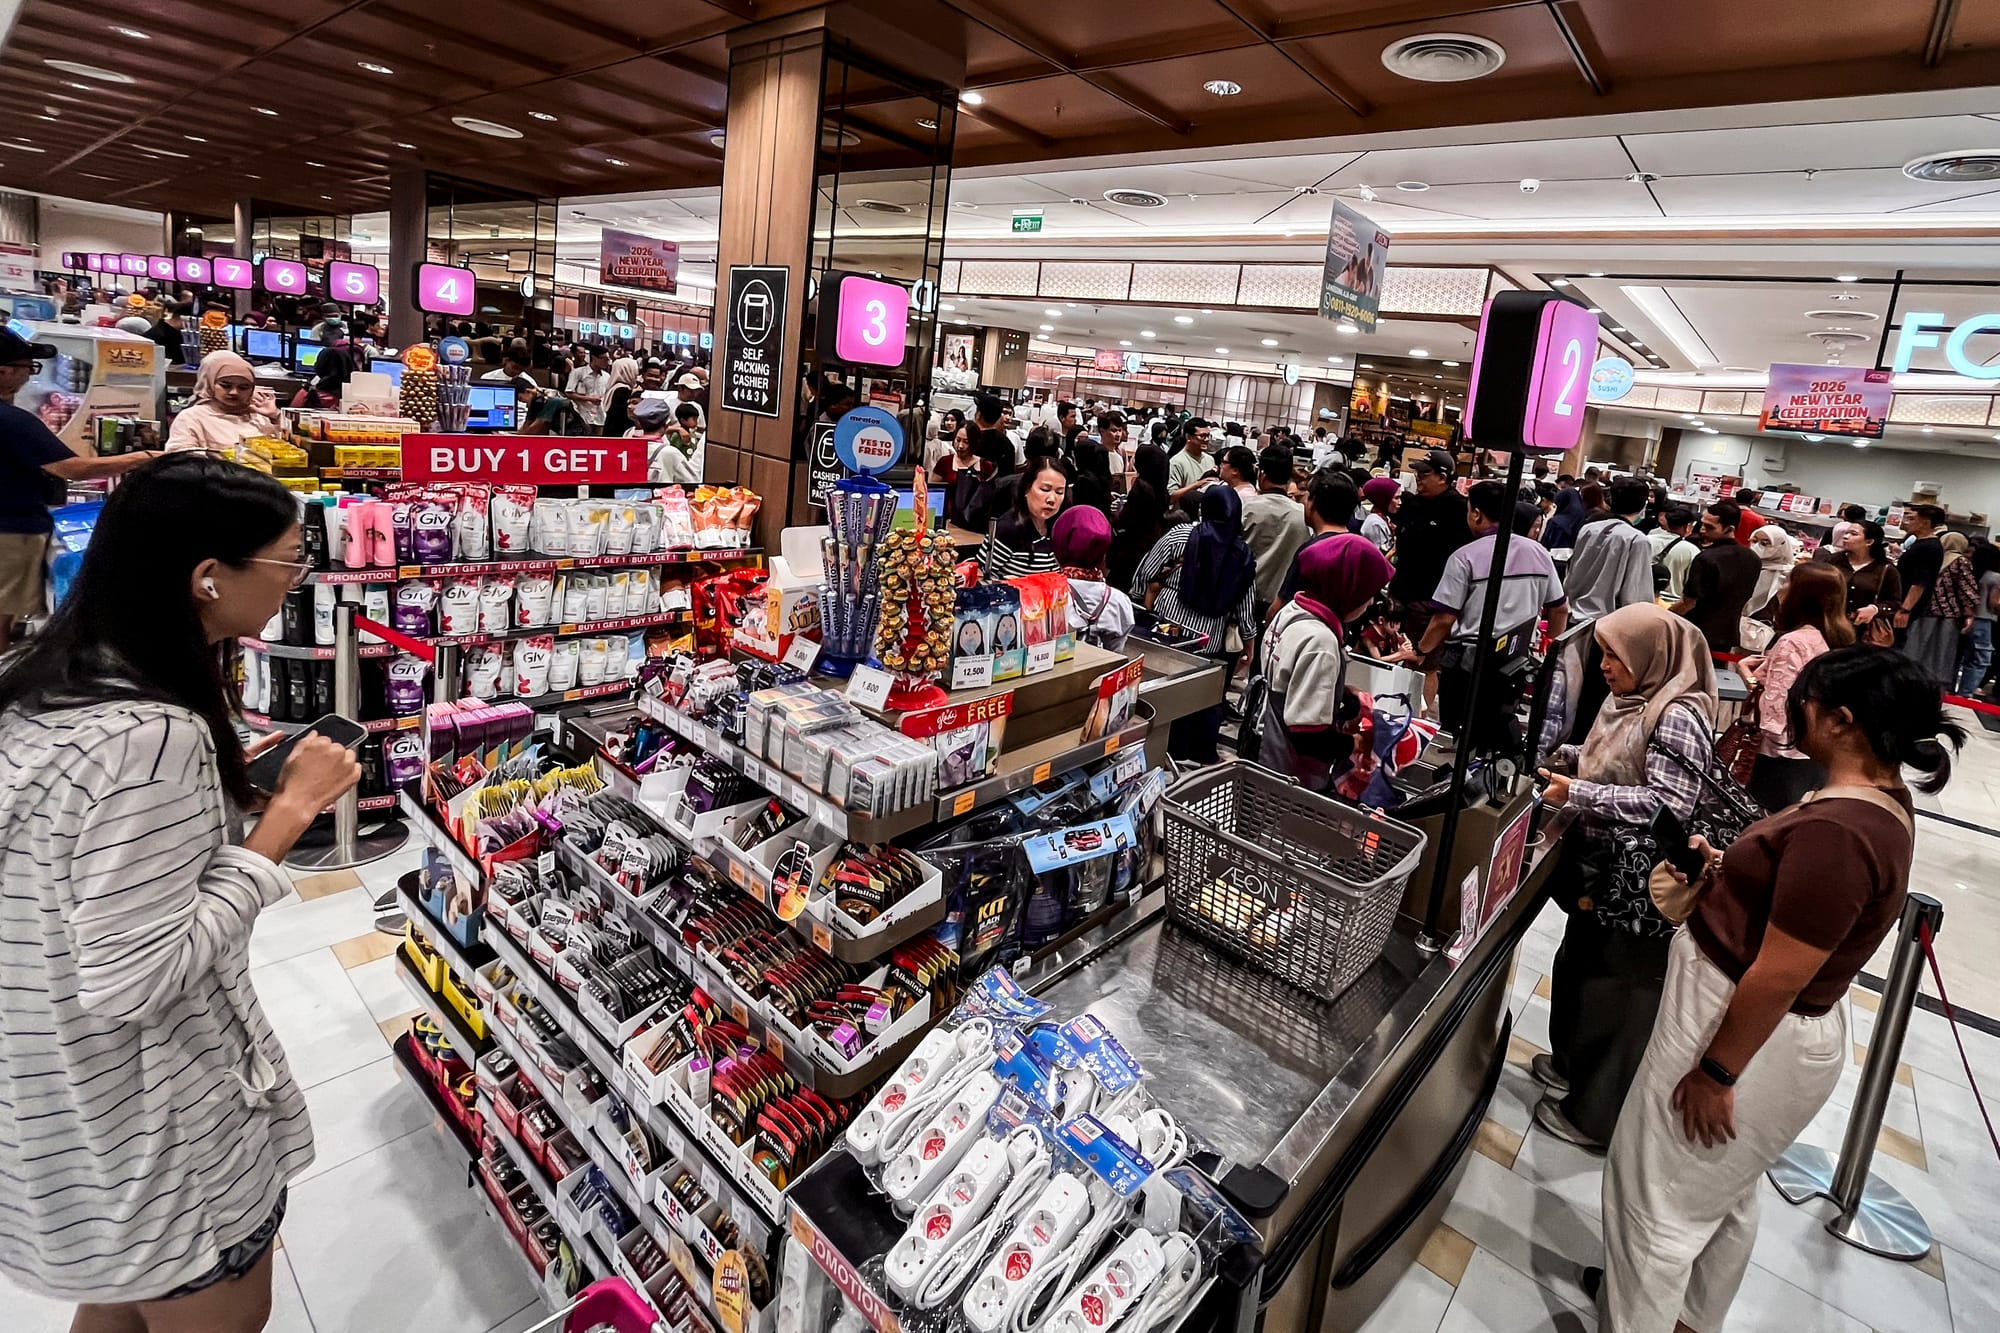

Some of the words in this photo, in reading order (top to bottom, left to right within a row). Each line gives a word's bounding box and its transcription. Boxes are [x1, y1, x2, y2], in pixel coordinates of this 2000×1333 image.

[631, 247, 652, 256] 2026
[124, 259, 148, 273] 10
[619, 255, 639, 266] NEW
[640, 257, 664, 267] YEAR
[157, 262, 171, 275] 9
[187, 263, 201, 278] 8
[226, 264, 241, 281] 7
[614, 266, 667, 277] CELEBRATION
[276, 269, 295, 287] 6
[344, 272, 365, 295] 5
[436, 278, 459, 304] 4
[862, 300, 888, 346] 3
[704, 336, 711, 345] 3
[742, 347, 764, 360] SELF
[733, 360, 770, 376] PACKING
[733, 374, 769, 390] CASHIER
[1554, 339, 1582, 416] 2
[1810, 381, 1846, 393] 2026
[740, 388, 745, 400] 4
[746, 389, 753, 401] &
[754, 390, 760, 402] 3
[1790, 394, 1821, 406] NEW
[1824, 394, 1863, 405] YEAR
[849, 414, 881, 425] mentos
[1780, 407, 1868, 419] CELEBRATION
[860, 438, 878, 447] YES
[879, 440, 892, 449] TO
[858, 446, 892, 458] FRESH
[430, 447, 507, 473] BUY
[517, 448, 530, 473] 1
[543, 448, 607, 473] GET
[616, 450, 630, 473] 1
[812, 469, 841, 481] CASHIER
[419, 512, 447, 525] Giv
[579, 557, 597, 565] BUY
[604, 556, 620, 564] GET
[632, 556, 648, 564] BUY
[655, 554, 671, 562] GET
[703, 552, 719, 560] BUY
[726, 551, 738, 559] GET
[430, 567, 451, 575] BUY
[462, 565, 481, 573] GET
[501, 562, 521, 570] BUY
[529, 561, 547, 569] GET
[326, 572, 392, 582] PROMOTION
[399, 588, 430, 601] Giv
[445, 586, 470, 599] Giv
[520, 583, 548, 594] Giv
[578, 623, 594, 631] BUY
[602, 621, 619, 629] GET
[630, 618, 645, 626] BUY
[653, 615, 669, 623] GET
[468, 653, 492, 666] Giv
[523, 652, 545, 664] Giv
[391, 663, 422, 675] Giv
[583, 687, 599, 697] BUY
[608, 684, 623, 692] GET
[967, 700, 1006, 723] FREE
[625, 852, 650, 867] Energizer
[839, 883, 881, 901] Alkaline
[978, 895, 1008, 924] KIT
[543, 911, 572, 924] Energizer
[604, 924, 630, 943] Energizer
[891, 967, 924, 995] Alkaline
[714, 1092, 743, 1124] Alkaline
[759, 1130, 791, 1164] Alkaline
[662, 1190, 683, 1223] ABC
